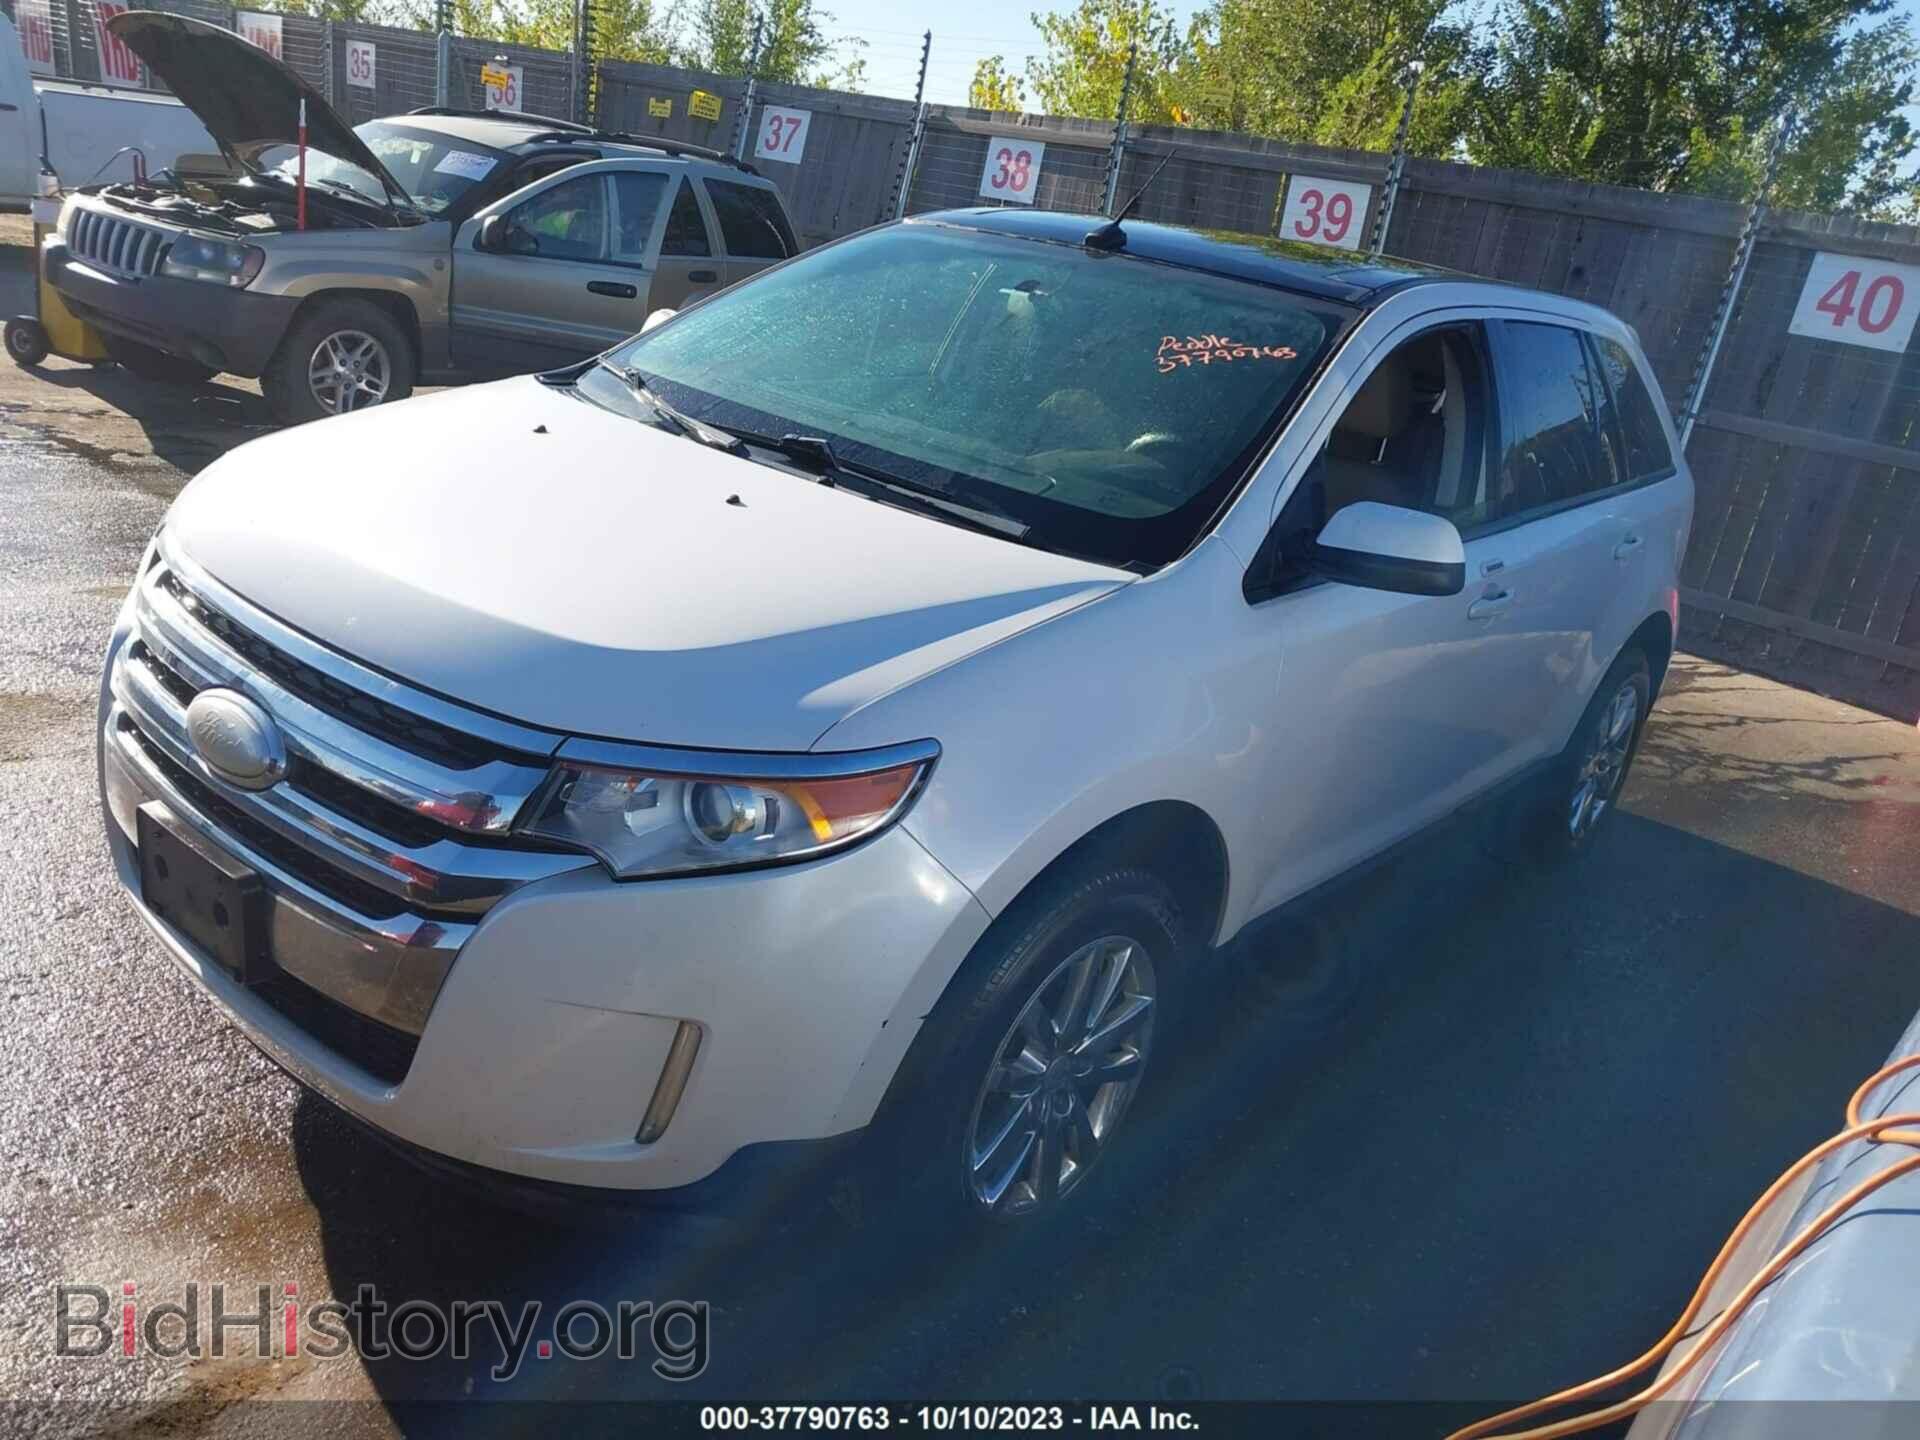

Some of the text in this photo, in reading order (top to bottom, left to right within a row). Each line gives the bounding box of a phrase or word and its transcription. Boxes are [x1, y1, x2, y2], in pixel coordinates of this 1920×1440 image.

[351, 48, 370, 80] 35
[765, 115, 802, 152] 37
[992, 148, 1032, 192] 38
[1295, 189, 1352, 242] 39
[1816, 271, 1904, 333] 40
